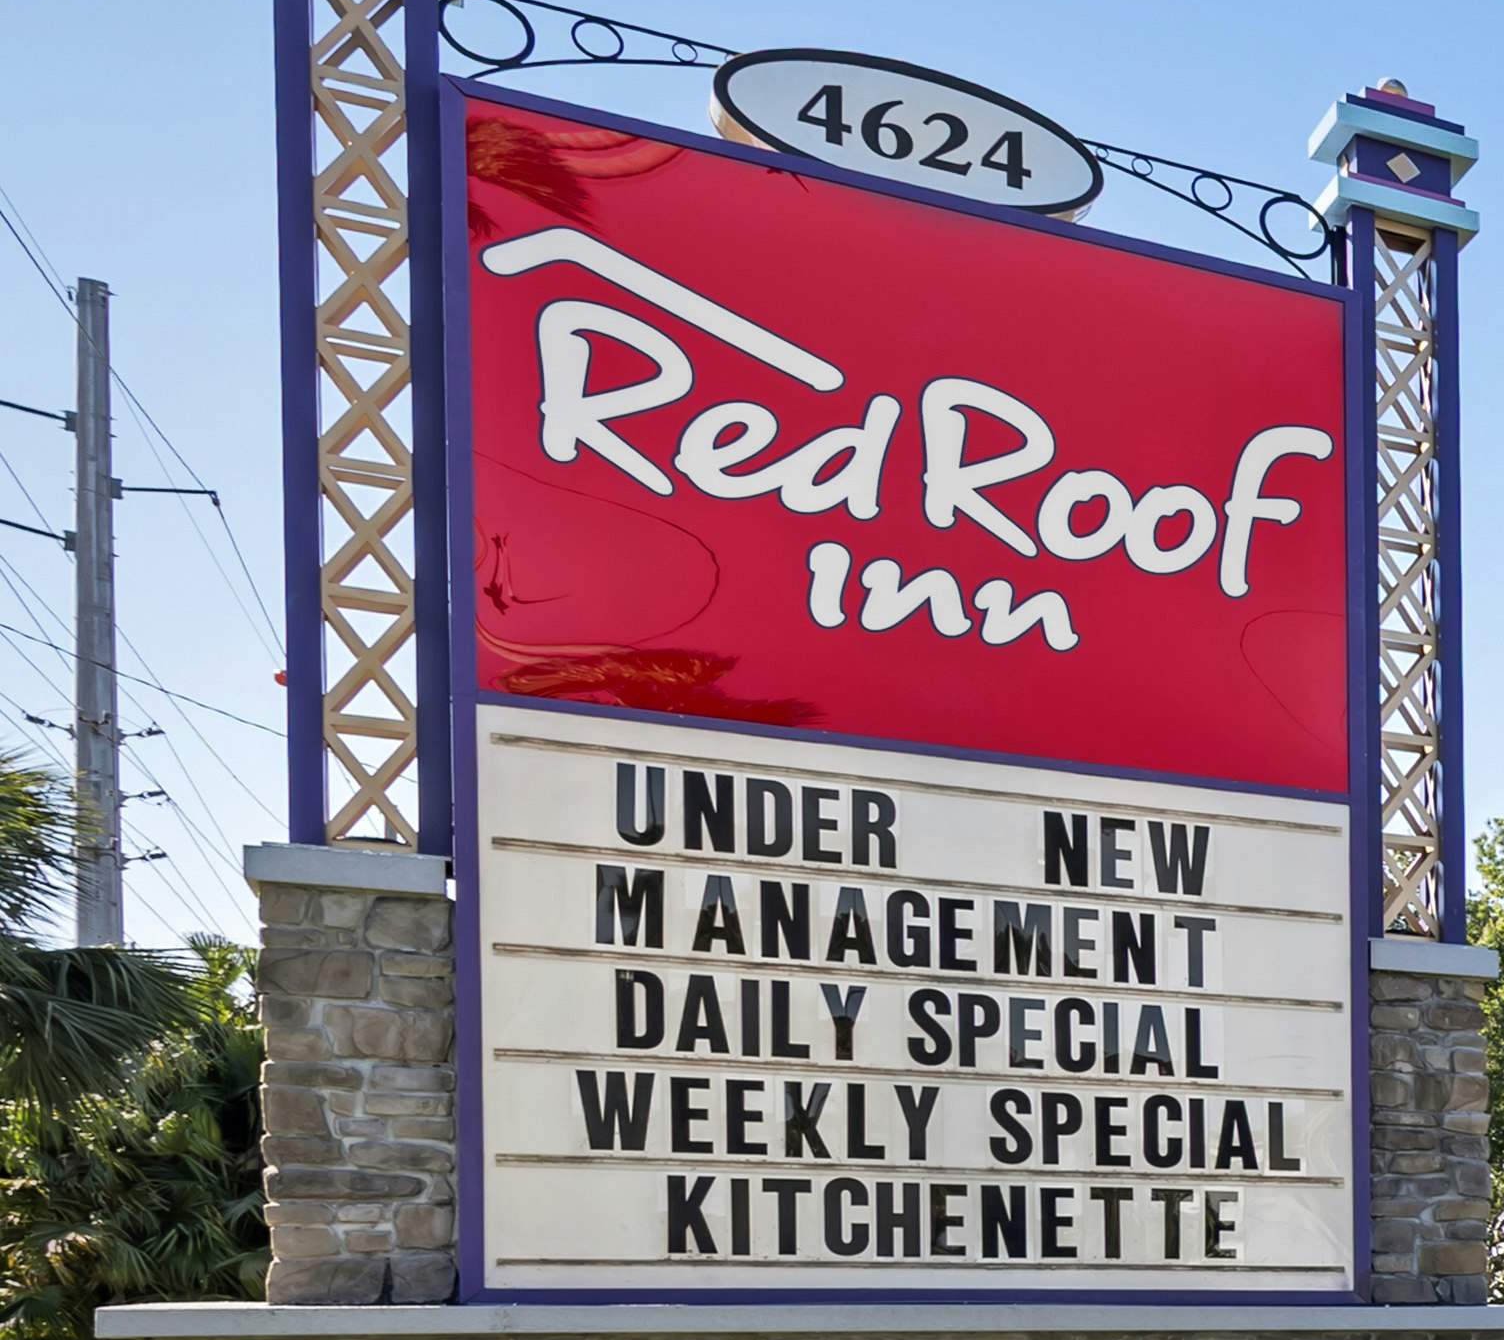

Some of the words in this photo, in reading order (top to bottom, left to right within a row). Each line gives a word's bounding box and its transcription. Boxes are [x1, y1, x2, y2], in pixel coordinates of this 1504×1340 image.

[797, 84, 1032, 191] 4624
[537, 299, 902, 521] Red
[920, 377, 1334, 598] Roof
[616, 762, 897, 869] UNDER
[1043, 810, 1211, 896] NEW
[596, 864, 1218, 987] MANAGEMENT
[615, 968, 867, 1062] DAILY
[906, 988, 1219, 1079] SPECIAL
[576, 1070, 941, 1161] WEEKLY
[989, 1088, 1301, 1172] SPECIAL
[667, 1175, 1239, 1259] KITCHENETTE
